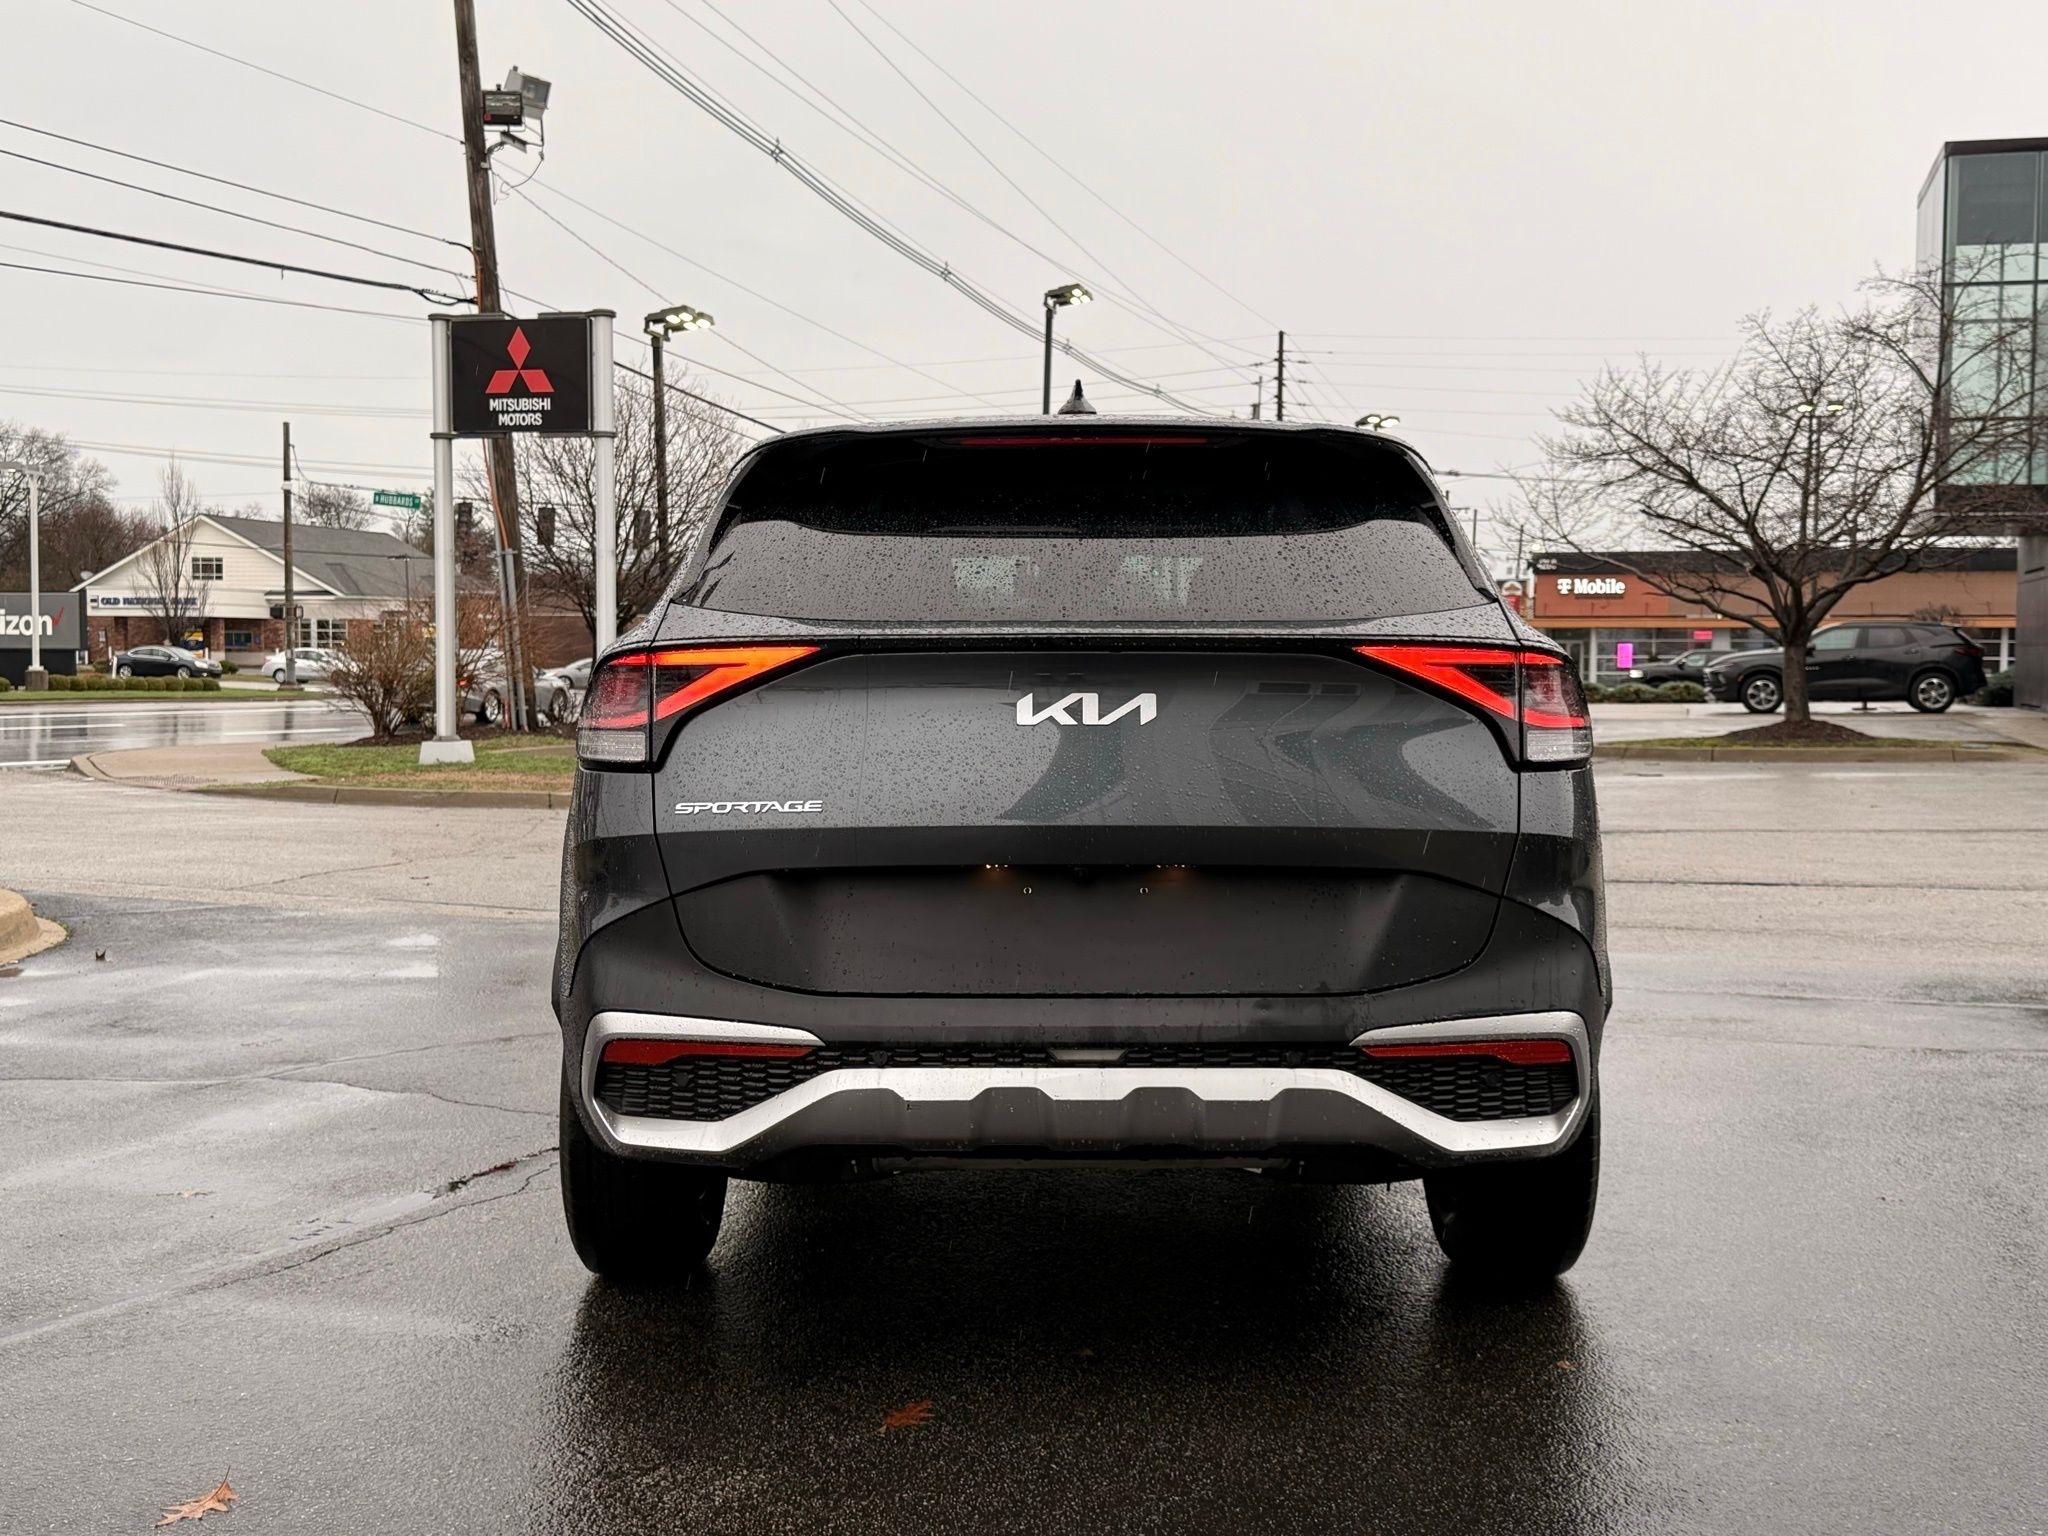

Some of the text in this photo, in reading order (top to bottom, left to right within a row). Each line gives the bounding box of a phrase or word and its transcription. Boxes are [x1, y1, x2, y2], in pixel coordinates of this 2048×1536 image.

[489, 397, 551, 412] MITSUBISHI
[498, 412, 543, 426] MOTORS
[1573, 578, 1626, 594] Mobile
[100, 597, 120, 606] OLD
[1016, 692, 1157, 726] KIA
[675, 800, 823, 814] SPORTAGE
